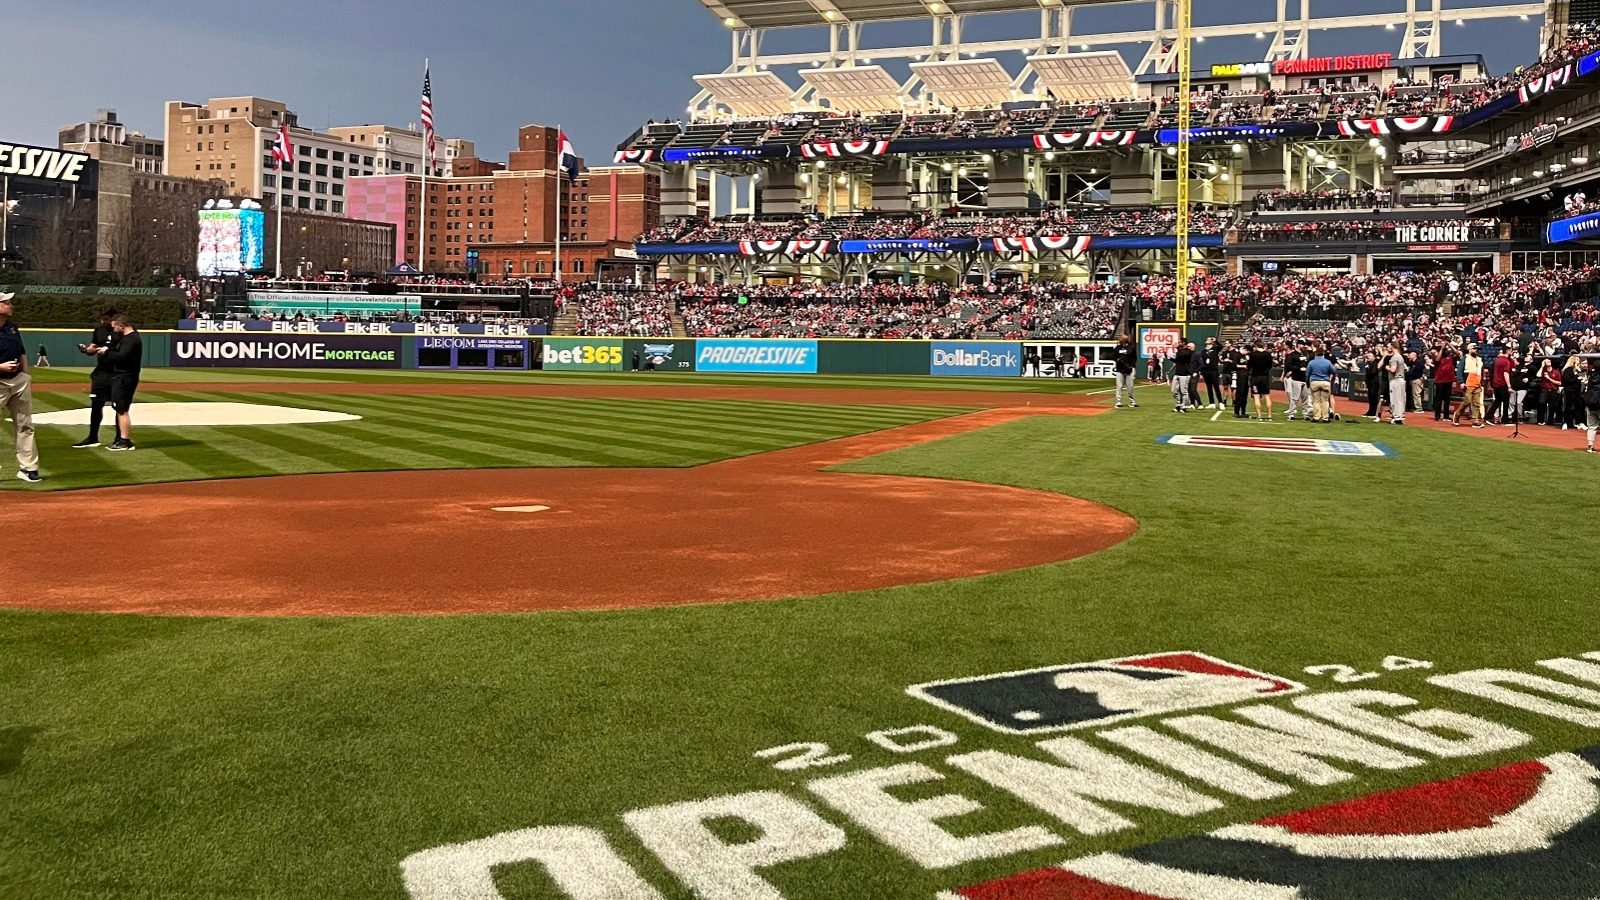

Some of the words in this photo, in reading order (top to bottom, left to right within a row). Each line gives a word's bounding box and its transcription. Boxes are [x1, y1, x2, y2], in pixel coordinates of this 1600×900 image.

[1275, 57, 1333, 75] PENNANT
[1334, 53, 1392, 71] DISTRICT
[1395, 226, 1418, 243] THE
[1420, 226, 1469, 242] CORNER
[98, 286, 160, 296] PROGRESSIVE
[267, 293, 290, 301] Official
[1144, 328, 1173, 345] drug
[543, 344, 622, 364] bet365
[698, 346, 810, 364] PROGRESSIVE
[1146, 343, 1177, 354] mart
[400, 688, 1533, 900] OPENING
